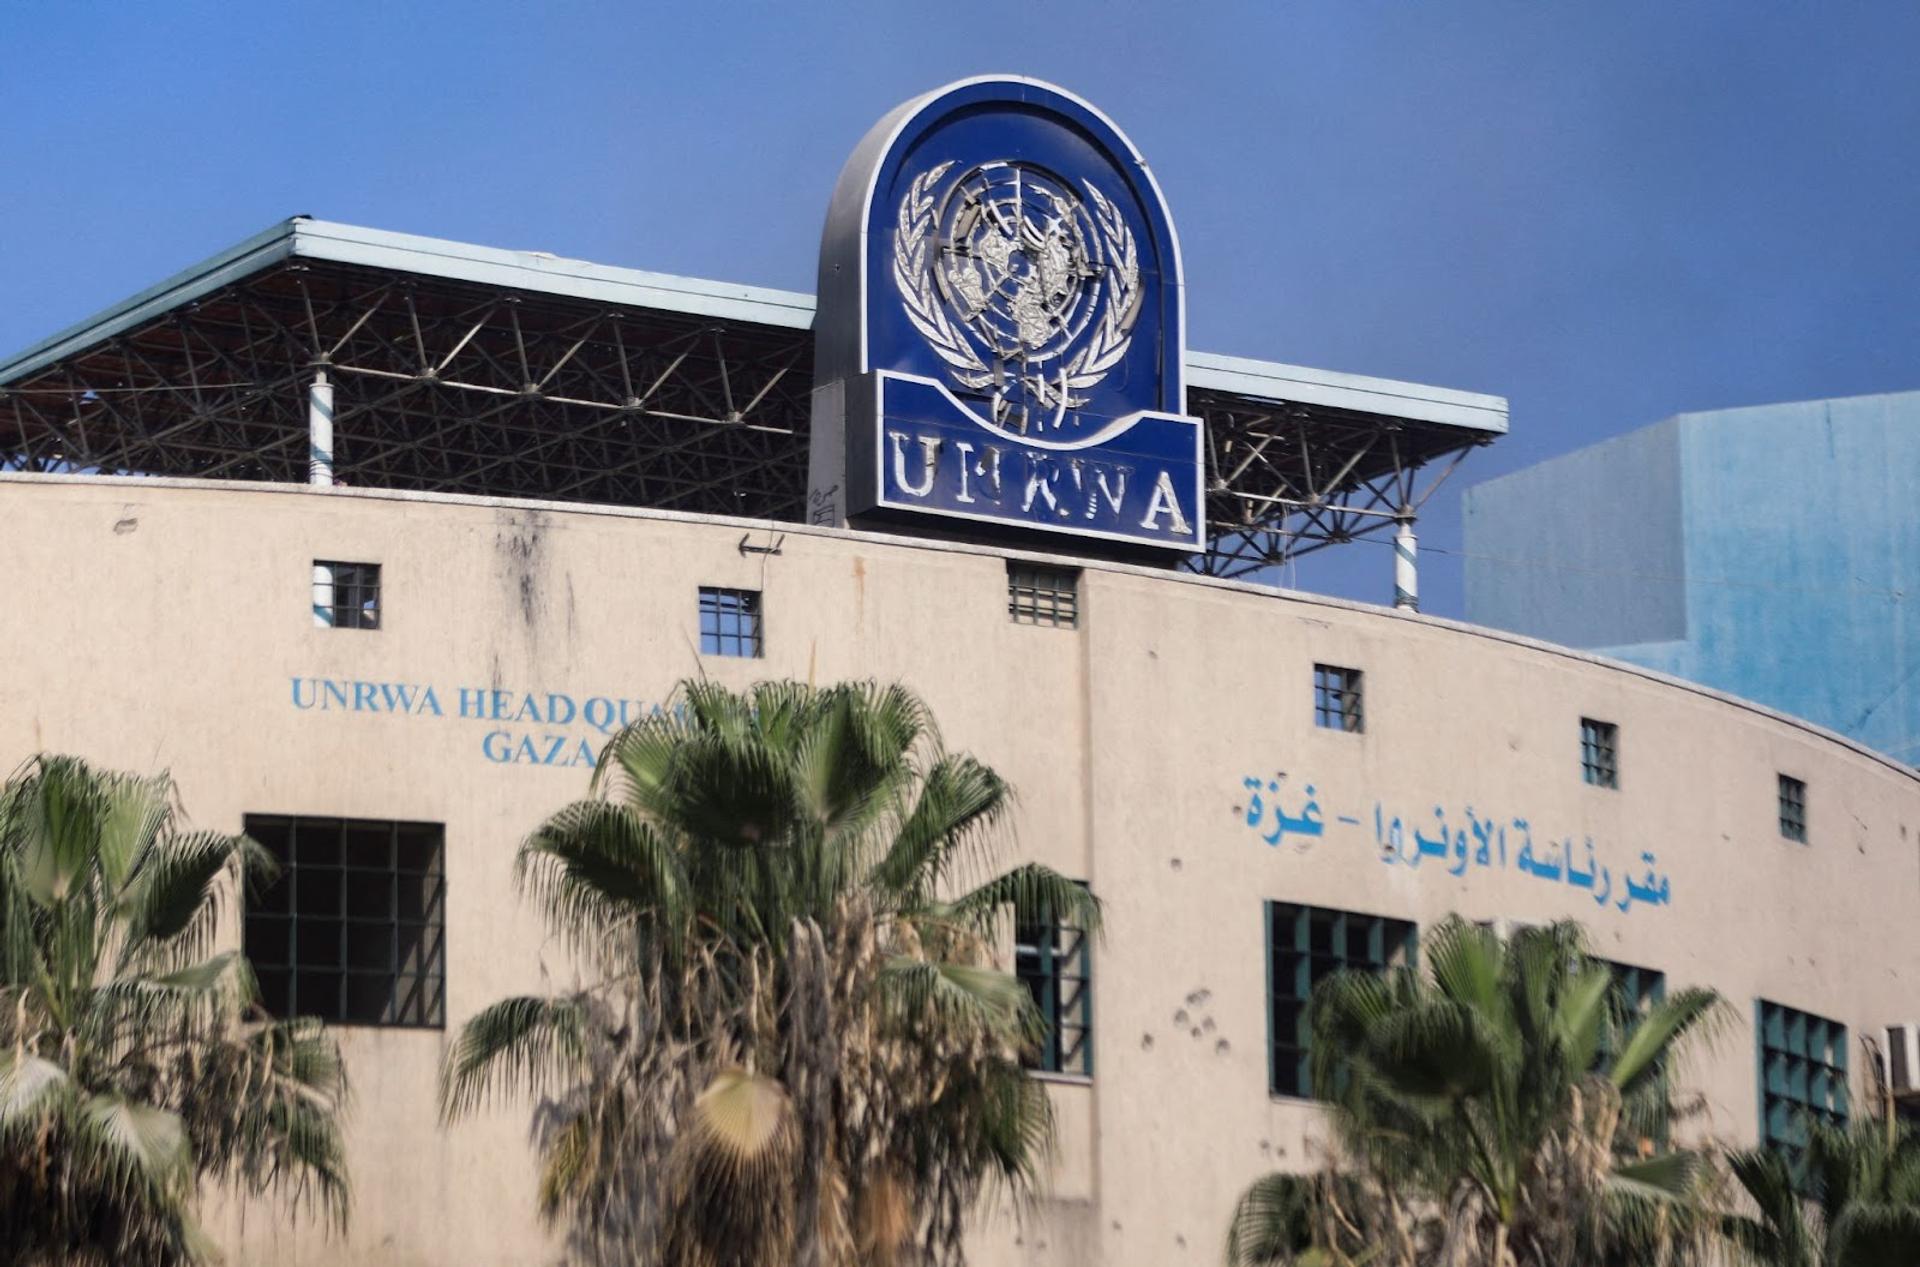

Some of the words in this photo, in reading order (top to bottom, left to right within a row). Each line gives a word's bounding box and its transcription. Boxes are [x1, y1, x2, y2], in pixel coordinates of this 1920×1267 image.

[290, 677, 443, 717] UNRWA
[482, 730, 597, 768] GAZA
[1242, 776, 1325, 847] غزة
[1511, 817, 1612, 907] رئاسة
[1616, 850, 1672, 913] مقر
